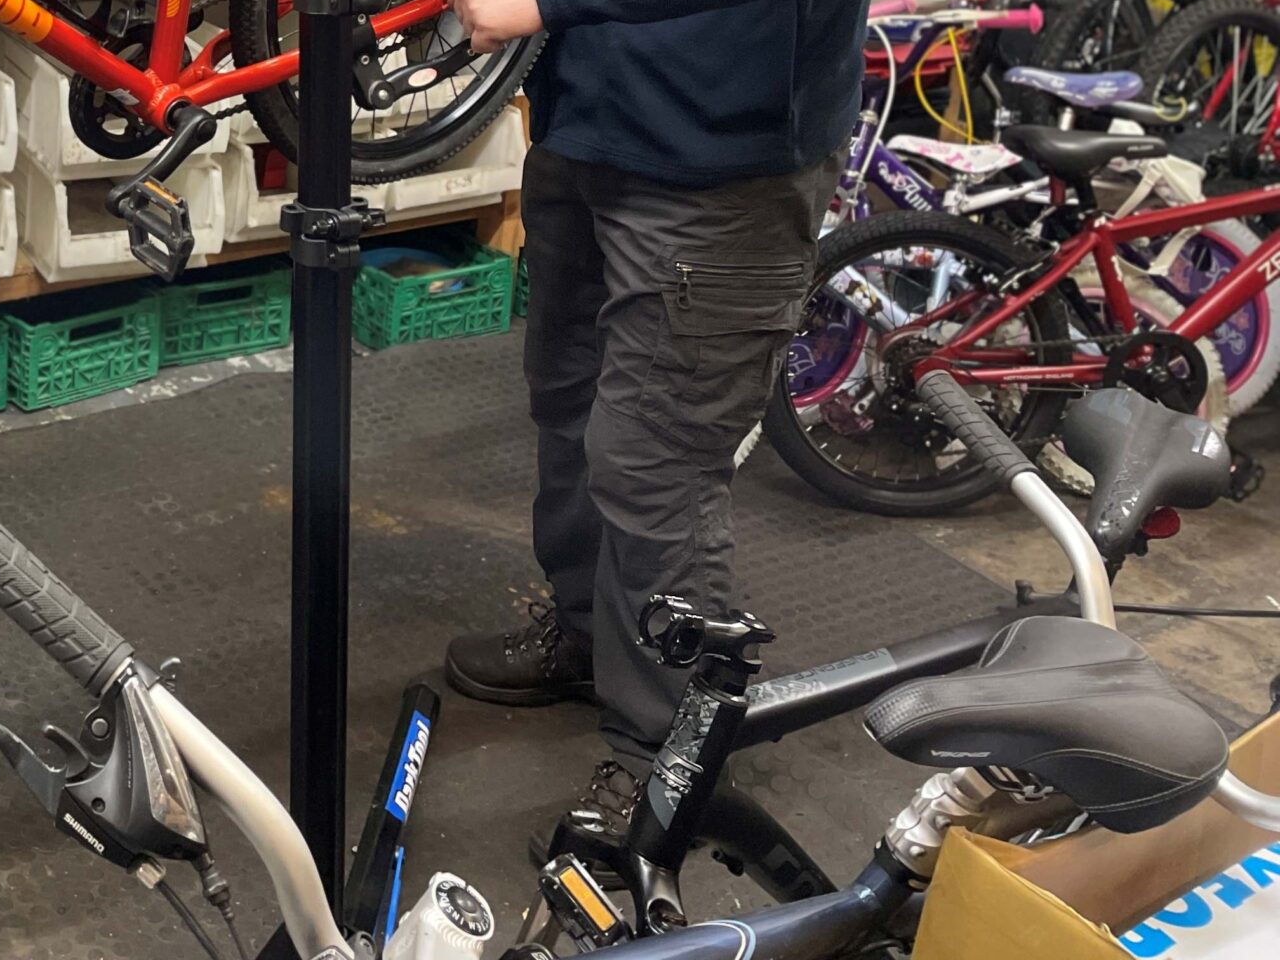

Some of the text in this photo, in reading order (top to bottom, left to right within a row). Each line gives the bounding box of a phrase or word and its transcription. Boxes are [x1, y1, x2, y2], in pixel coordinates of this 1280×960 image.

[407, 719, 430, 768] Tool
[930, 749, 992, 758] VIKING
[63, 812, 105, 855] SHIMANO
